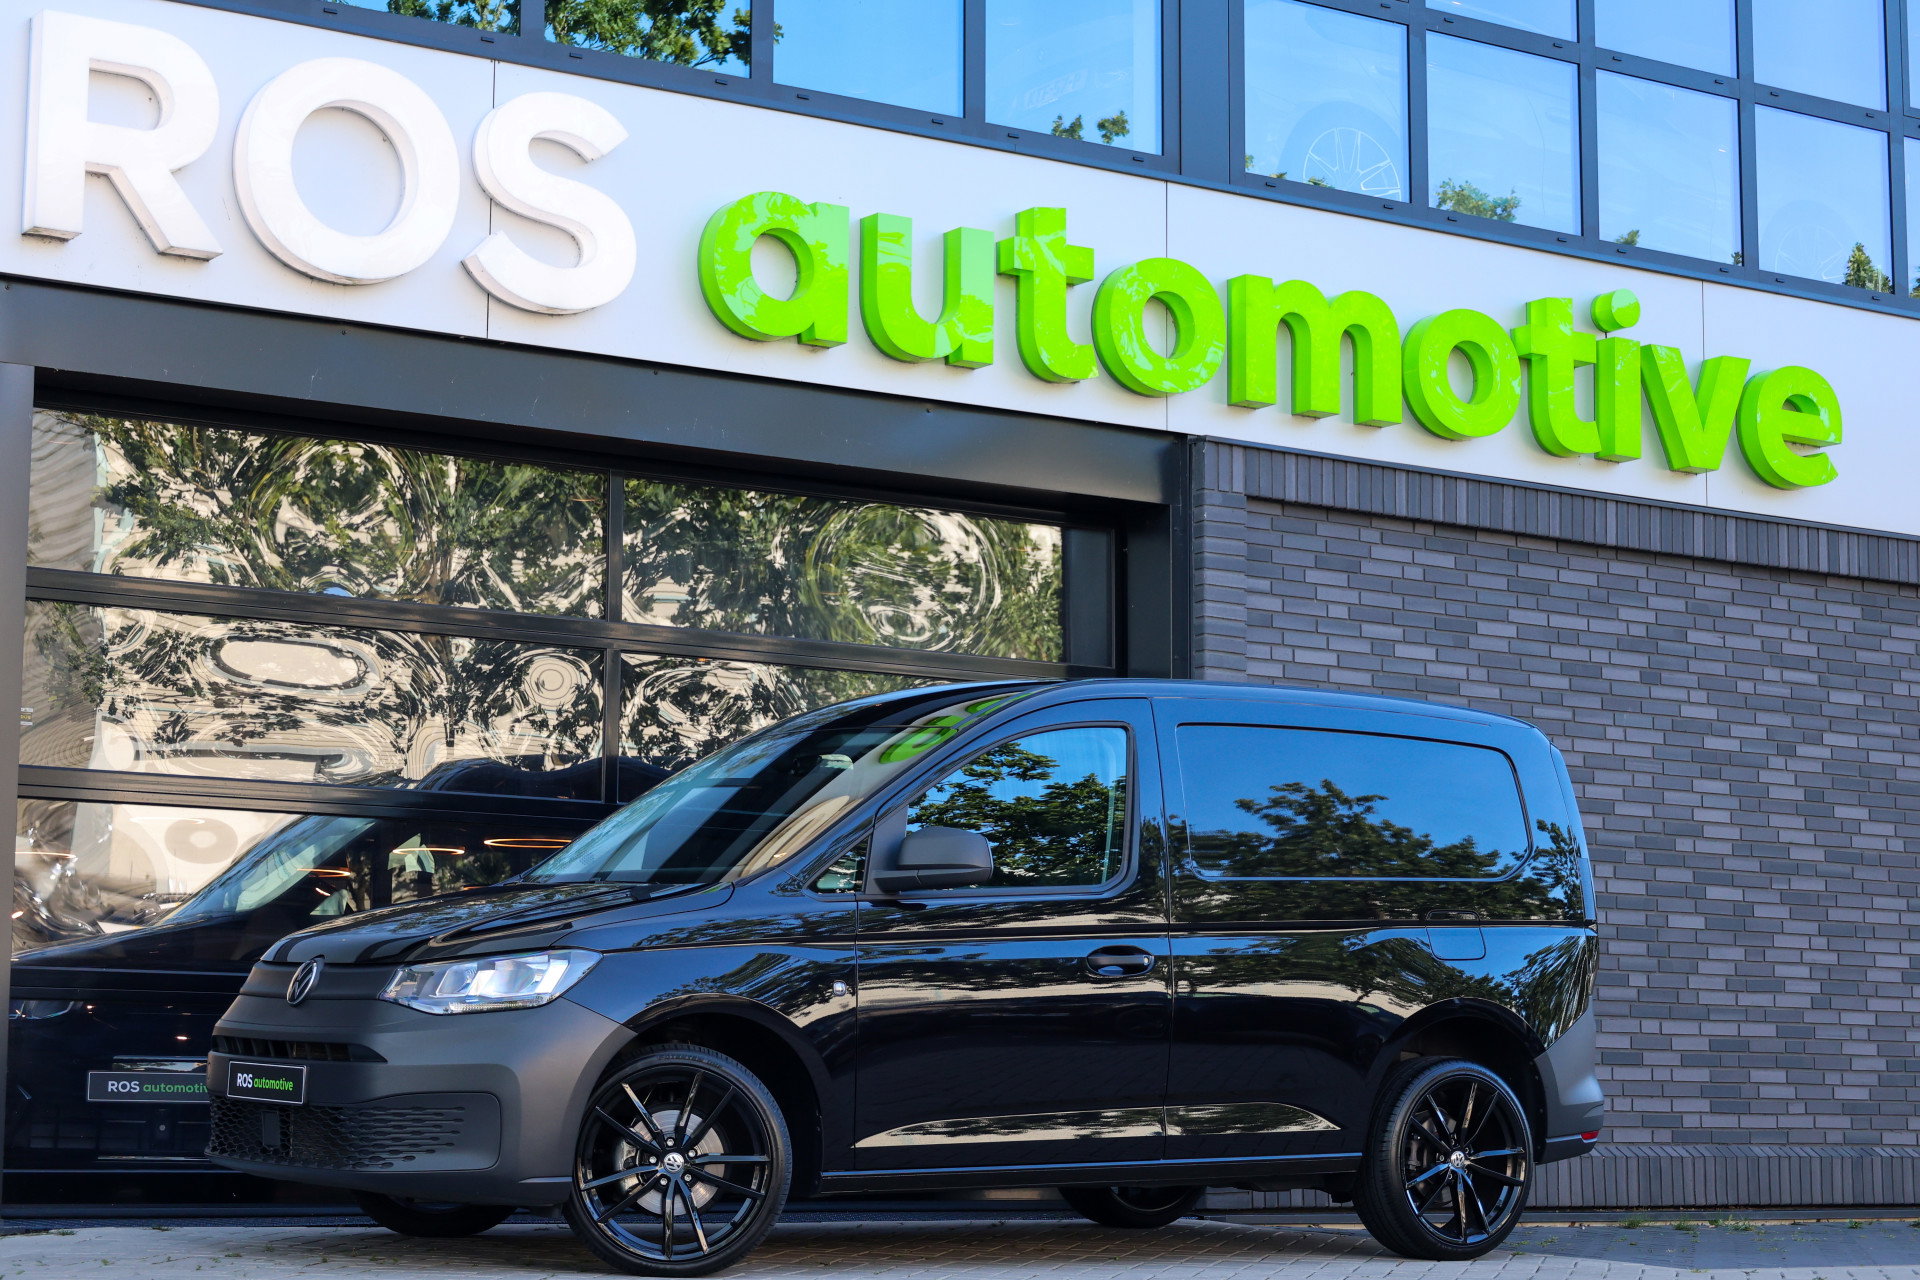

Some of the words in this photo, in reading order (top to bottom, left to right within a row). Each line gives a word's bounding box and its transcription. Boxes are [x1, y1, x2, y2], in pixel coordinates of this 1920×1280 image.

[21, 8, 637, 316] ROS
[698, 190, 1842, 491] automotive
[107, 1080, 140, 1093] ROS
[143, 1083, 208, 1093] automotiv
[236, 1073, 253, 1088] ROS
[253, 1076, 294, 1091] automotive
